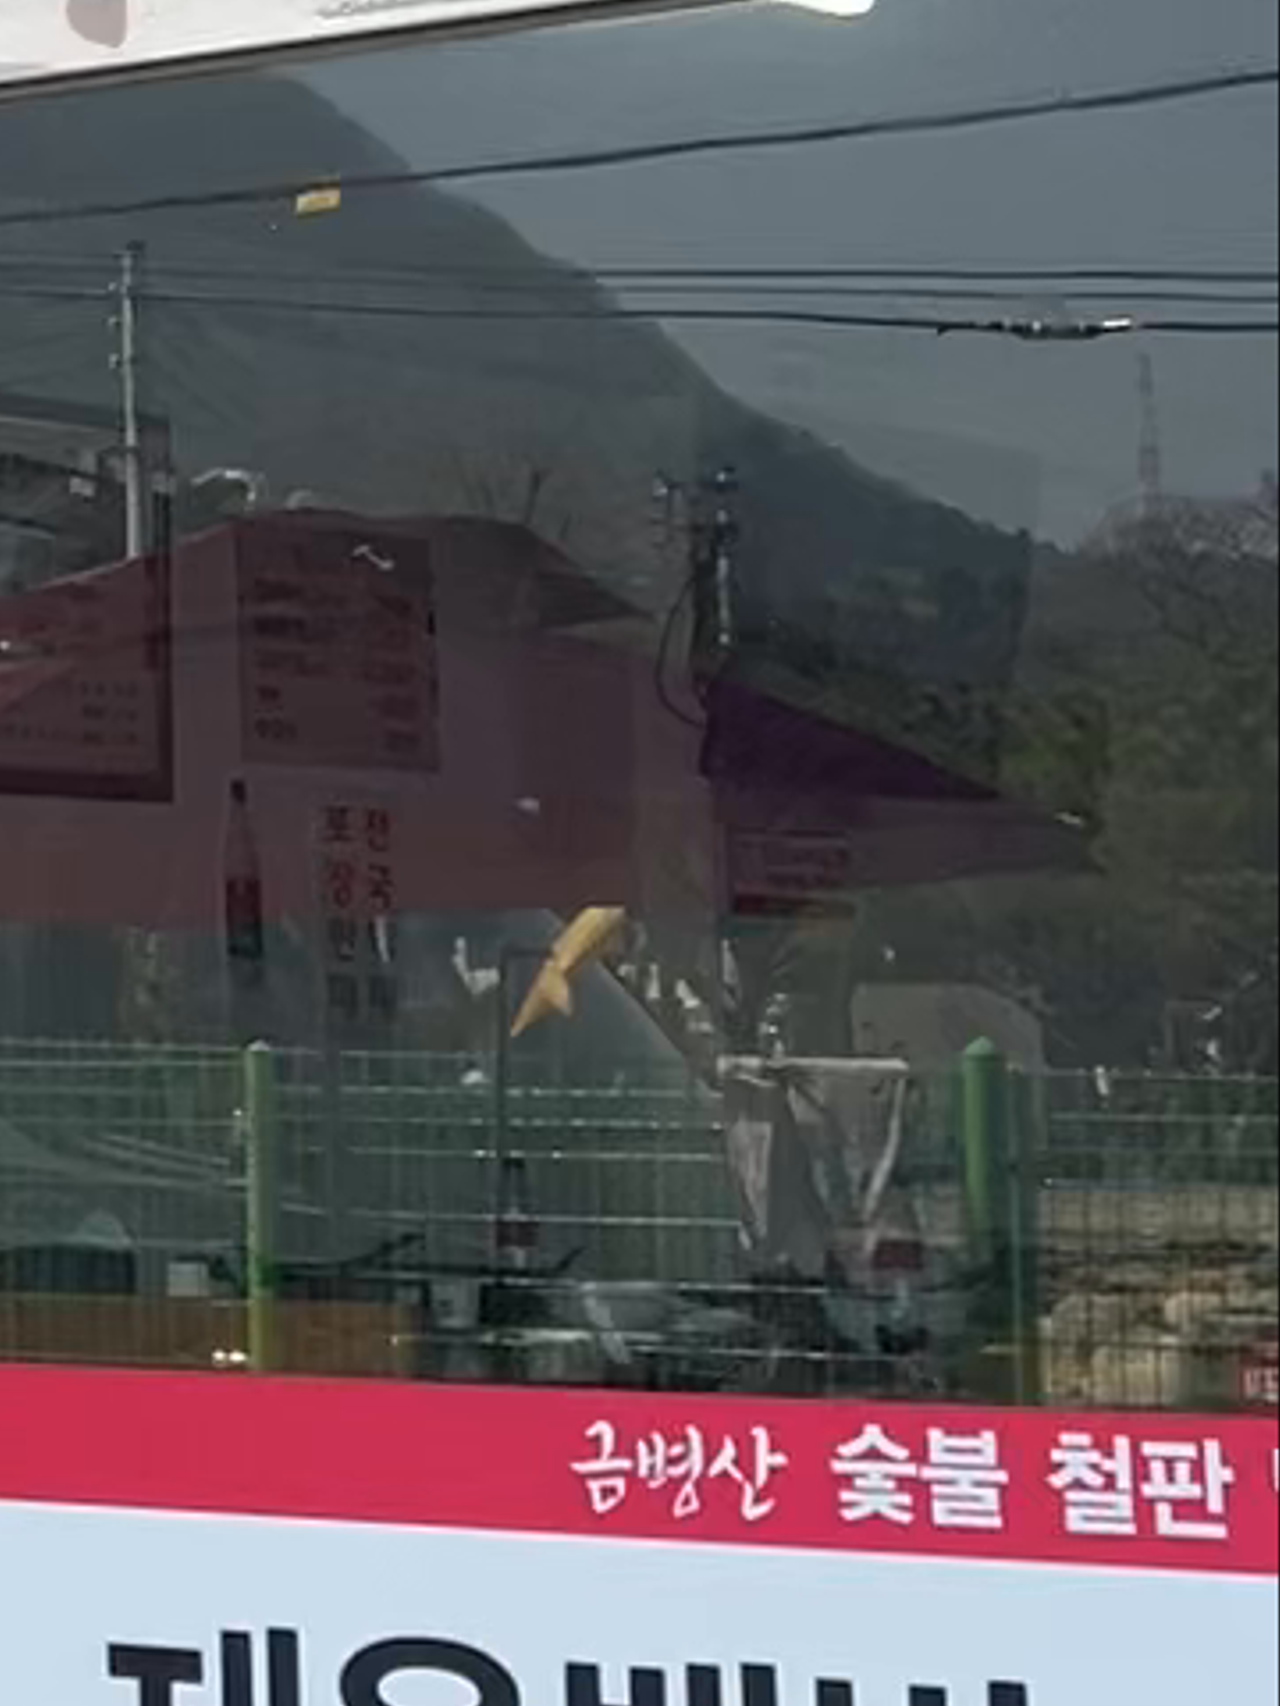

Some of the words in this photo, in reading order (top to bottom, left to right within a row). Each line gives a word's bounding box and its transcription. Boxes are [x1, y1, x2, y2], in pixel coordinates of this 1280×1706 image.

[569, 1418, 788, 1522] 금병산
[830, 1422, 1009, 1530] 숯불
[1044, 1430, 1235, 1541] 철판
